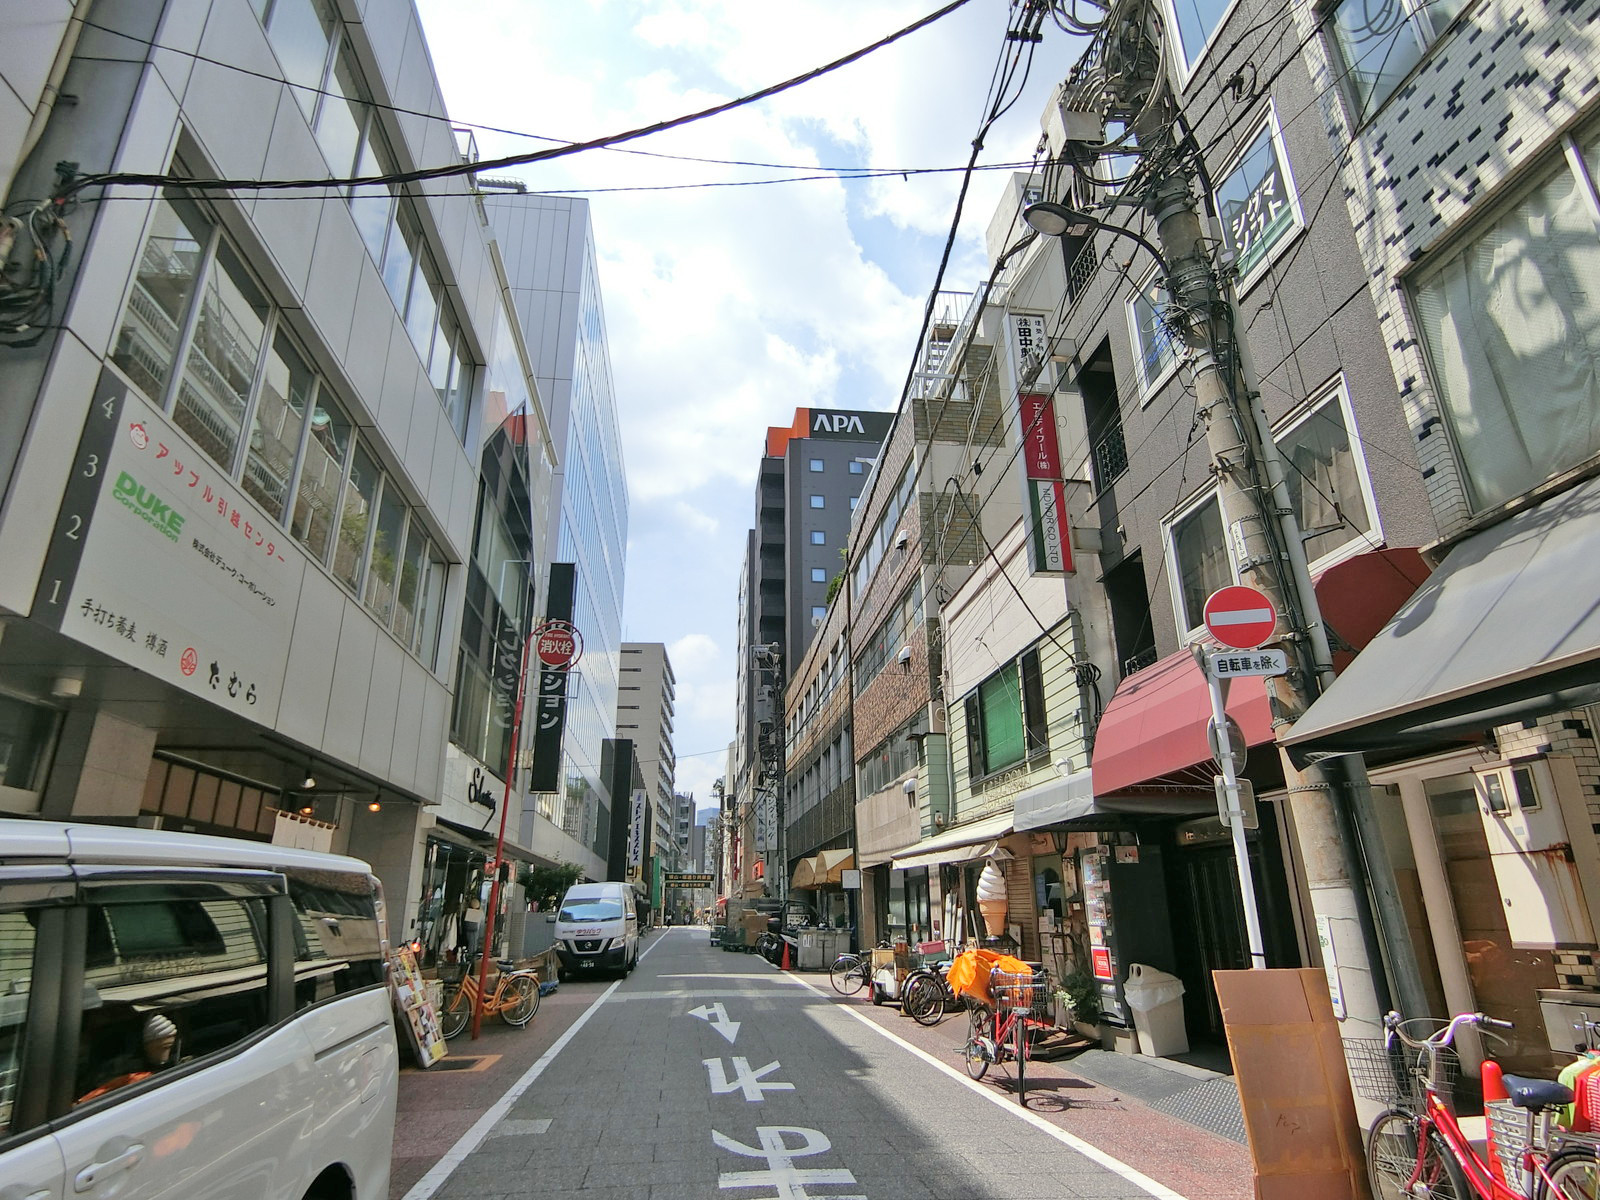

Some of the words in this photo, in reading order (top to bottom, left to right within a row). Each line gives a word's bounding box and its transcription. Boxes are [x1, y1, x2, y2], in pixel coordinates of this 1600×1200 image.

[1232, 171, 1275, 240] シグマ
[1236, 199, 1282, 255] ソフト
[102, 396, 116, 420] 4
[813, 413, 866, 434] APA
[83, 454, 98, 478] 3
[112, 488, 179, 543] Corporation
[115, 470, 186, 535] DUKE
[155, 442, 285, 563] アップル引越センター
[66, 515, 82, 541] 2
[48, 579, 60, 605] 1
[80, 598, 136, 643] 手打ち蕎麦
[540, 639, 573, 655] 消火栓
[1217, 655, 1280, 673] 自転車を除く
[209, 660, 257, 705] たむら
